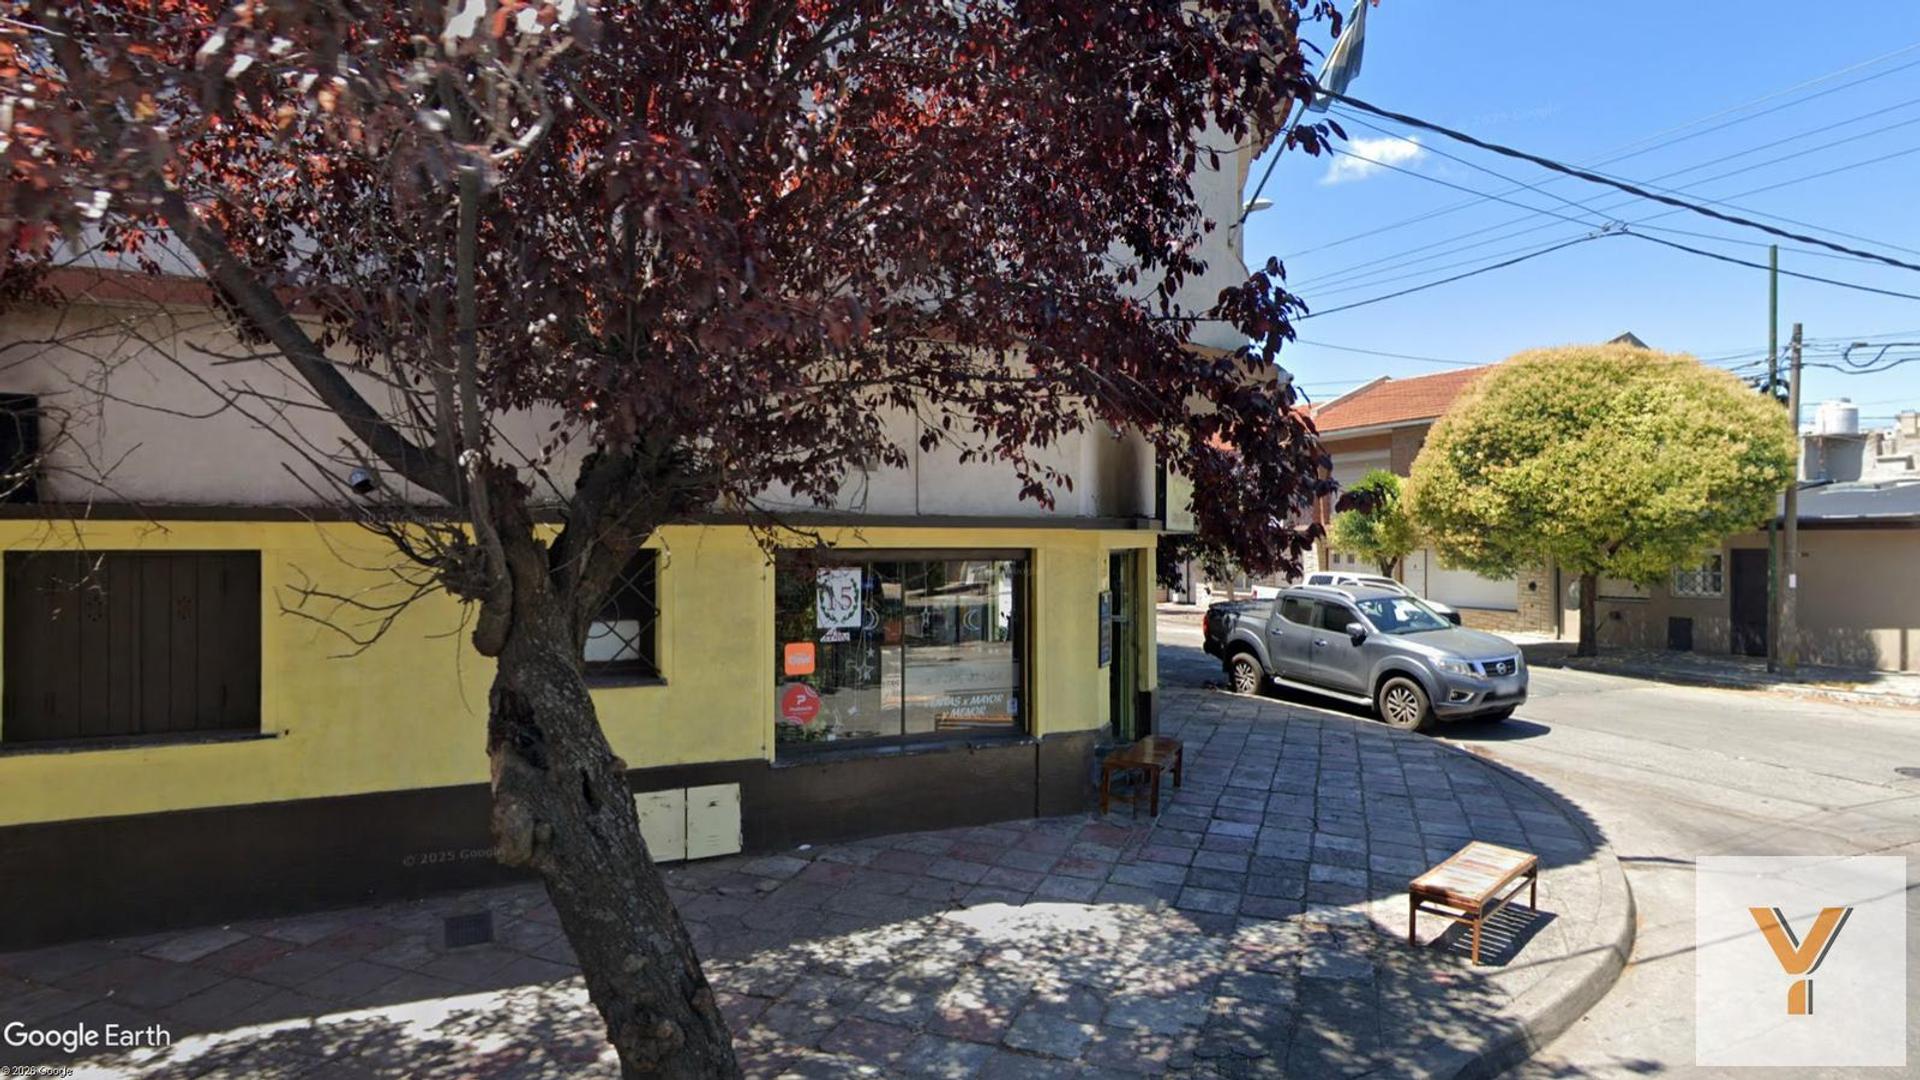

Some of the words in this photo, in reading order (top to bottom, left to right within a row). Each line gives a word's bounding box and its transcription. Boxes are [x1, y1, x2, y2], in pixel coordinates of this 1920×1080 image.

[828, 585, 853, 612] 15
[969, 693, 1004, 705] MAYOR
[950, 705, 987, 718] MENOR
